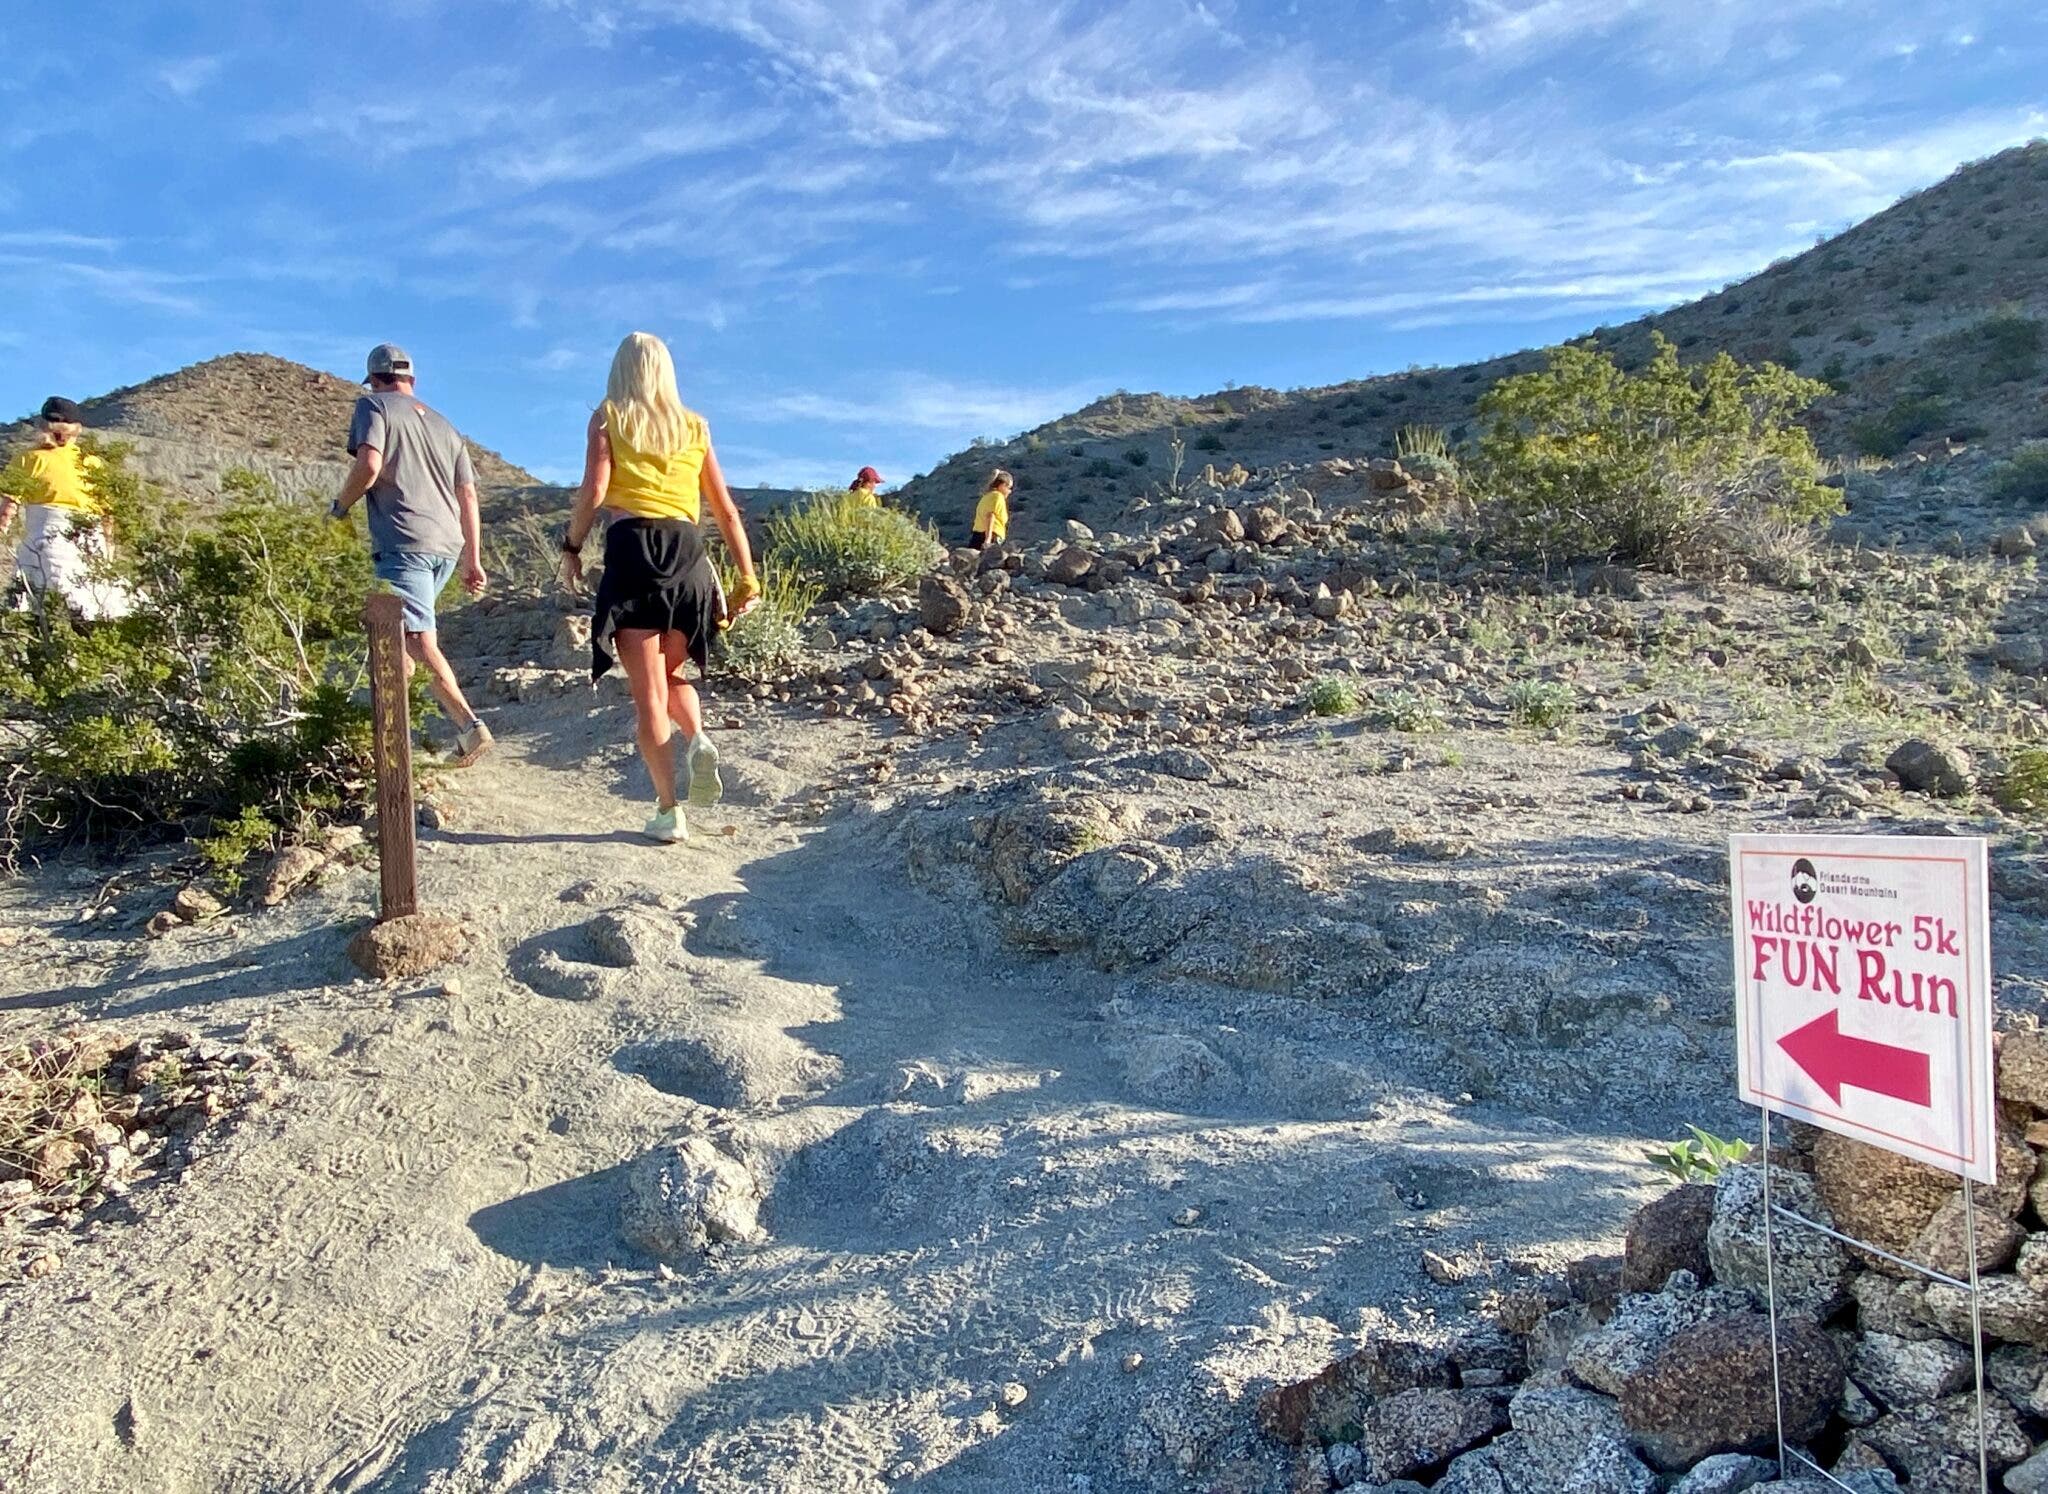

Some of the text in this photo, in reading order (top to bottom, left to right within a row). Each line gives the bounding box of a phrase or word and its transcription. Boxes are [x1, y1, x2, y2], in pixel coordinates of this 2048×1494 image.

[1820, 871, 1850, 883] Friends
[1820, 883, 1897, 899] Desert Mountains
[1748, 900, 1960, 956] Wildflower 5k
[1751, 934, 1958, 1019] FUN Run
